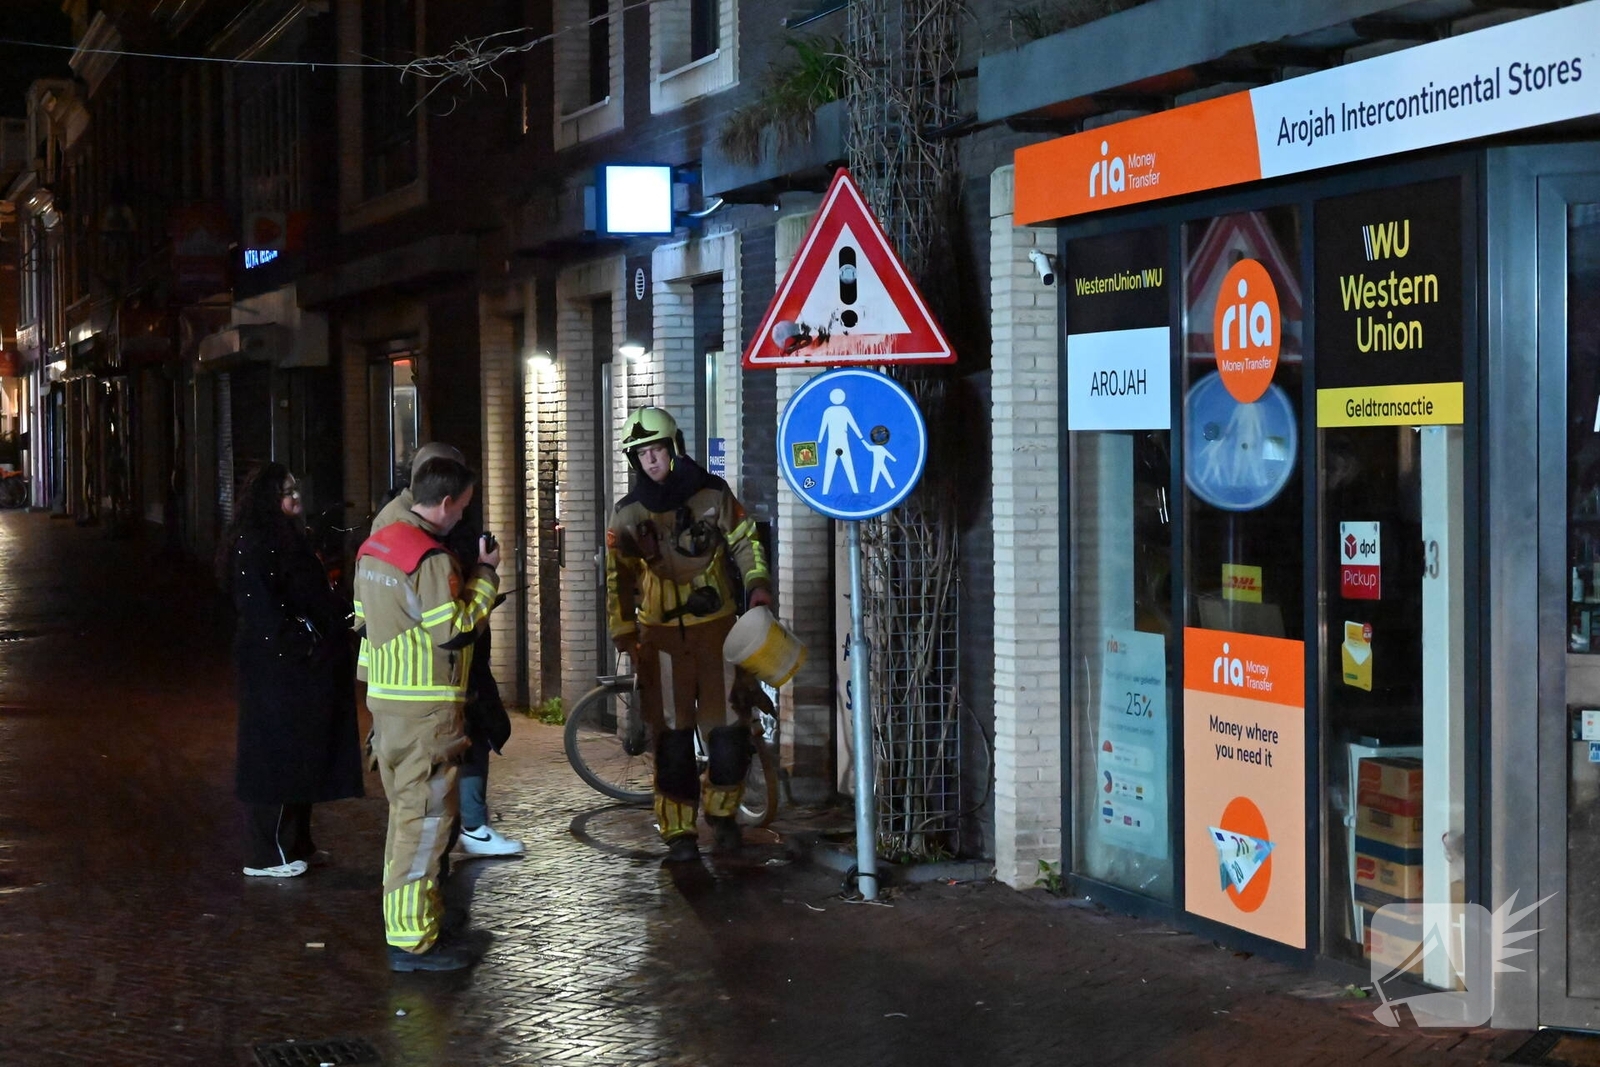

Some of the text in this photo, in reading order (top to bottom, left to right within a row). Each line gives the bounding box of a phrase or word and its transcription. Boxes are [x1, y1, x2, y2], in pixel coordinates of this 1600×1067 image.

[1277, 57, 1582, 147] Arojah Intercontinental Stores
[1089, 140, 1125, 198] ria
[1128, 152, 1156, 169] Money
[1128, 169, 1161, 190] Transfer
[1340, 270, 1439, 311] Western
[1222, 278, 1273, 351] ria
[1357, 310, 1423, 353] Union
[1222, 356, 1273, 374] Money Transfer
[1090, 369, 1147, 397] AROJAH
[1345, 396, 1434, 418] Geldtransactie
[1360, 539, 1376, 558] dpd
[1344, 570, 1377, 589] Pickup
[1213, 642, 1244, 687] ria
[1245, 660, 1269, 678] Money
[1246, 675, 1273, 692] Transfer
[1126, 691, 1152, 718] 25%
[1209, 714, 1279, 744] Money where
[1215, 743, 1273, 768] you need it
